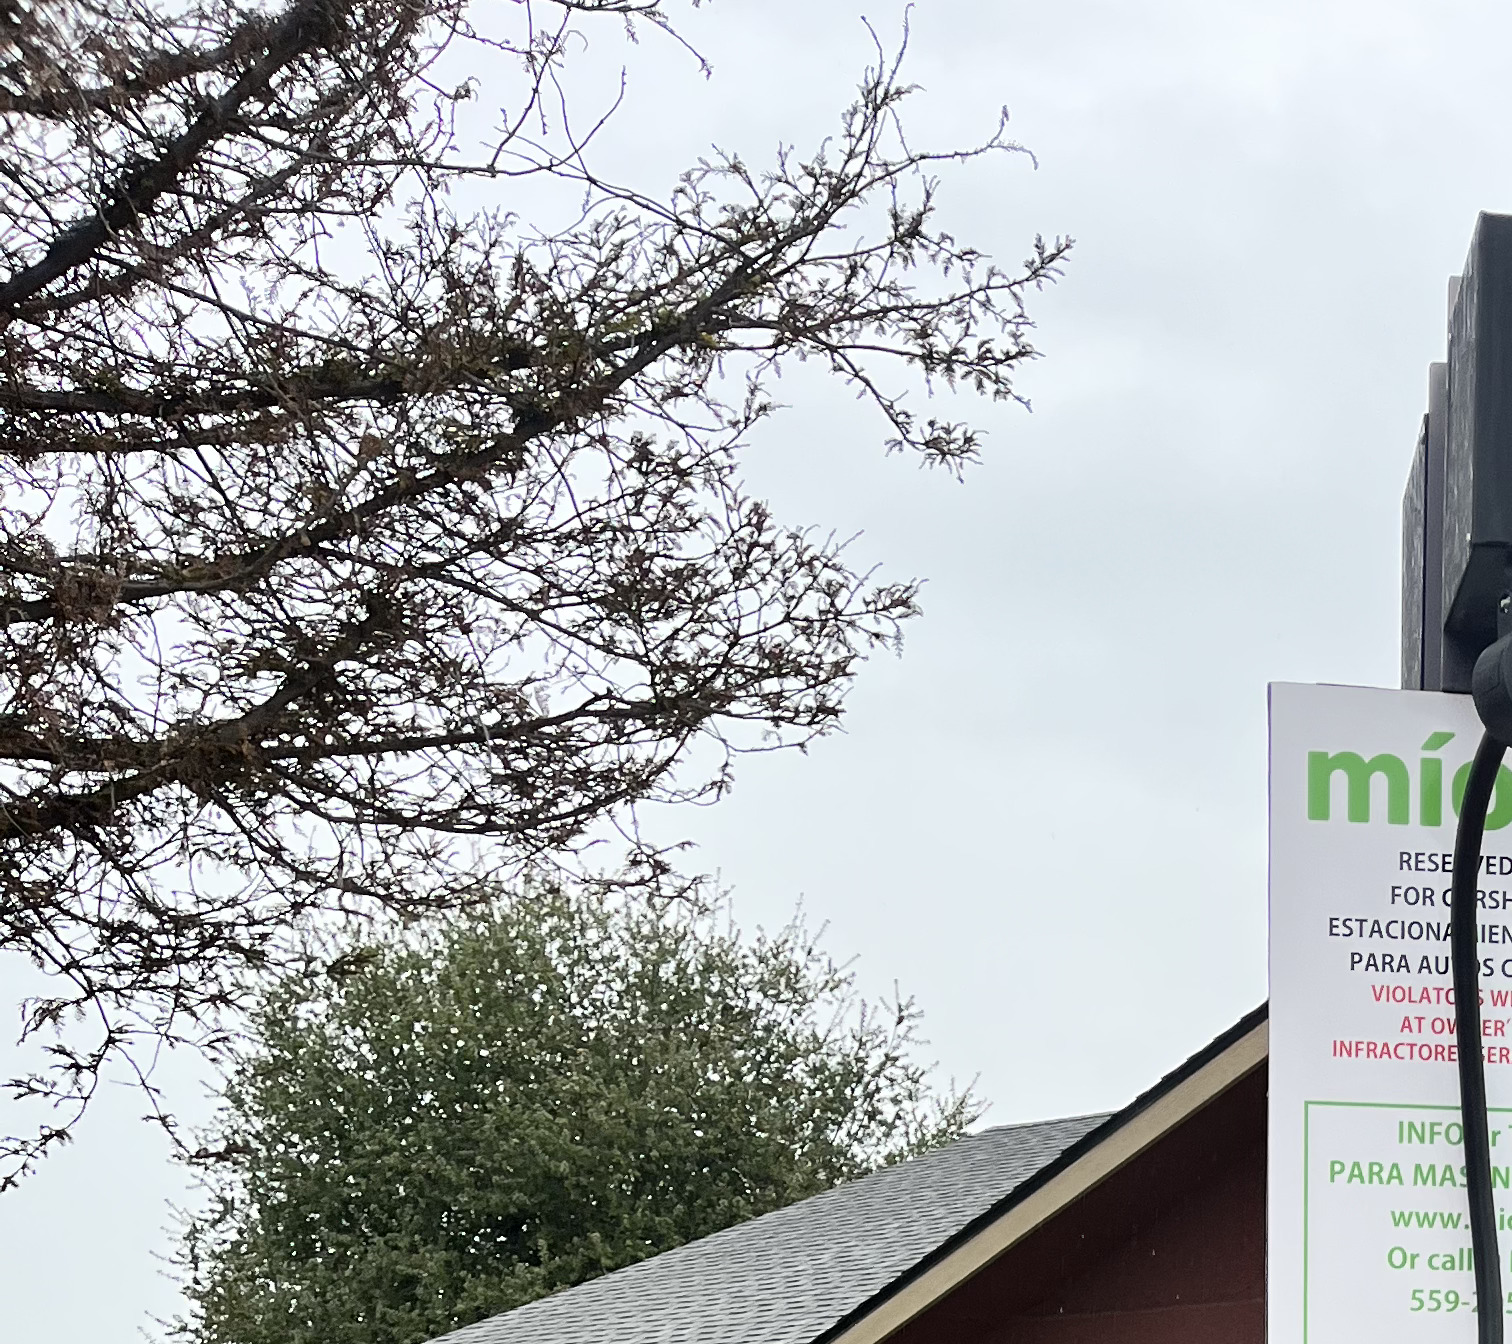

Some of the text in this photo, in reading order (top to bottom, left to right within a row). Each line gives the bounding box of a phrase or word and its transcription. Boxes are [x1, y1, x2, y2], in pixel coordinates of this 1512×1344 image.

[1390, 885, 1435, 907] FOR
[1350, 952, 1411, 974] PARA
[1417, 955, 1495, 977] AUS
[1371, 984, 1484, 1006] VIOLATOS
[1399, 1016, 1426, 1034] AT
[1332, 1039, 1458, 1062] INFRACTORE
[1398, 1121, 1464, 1146] INFO
[1329, 1160, 1404, 1186] PARA
[1412, 1163, 1468, 1188] MAS
[1387, 1246, 1420, 1270] Or
[1427, 1247, 1473, 1271] call
